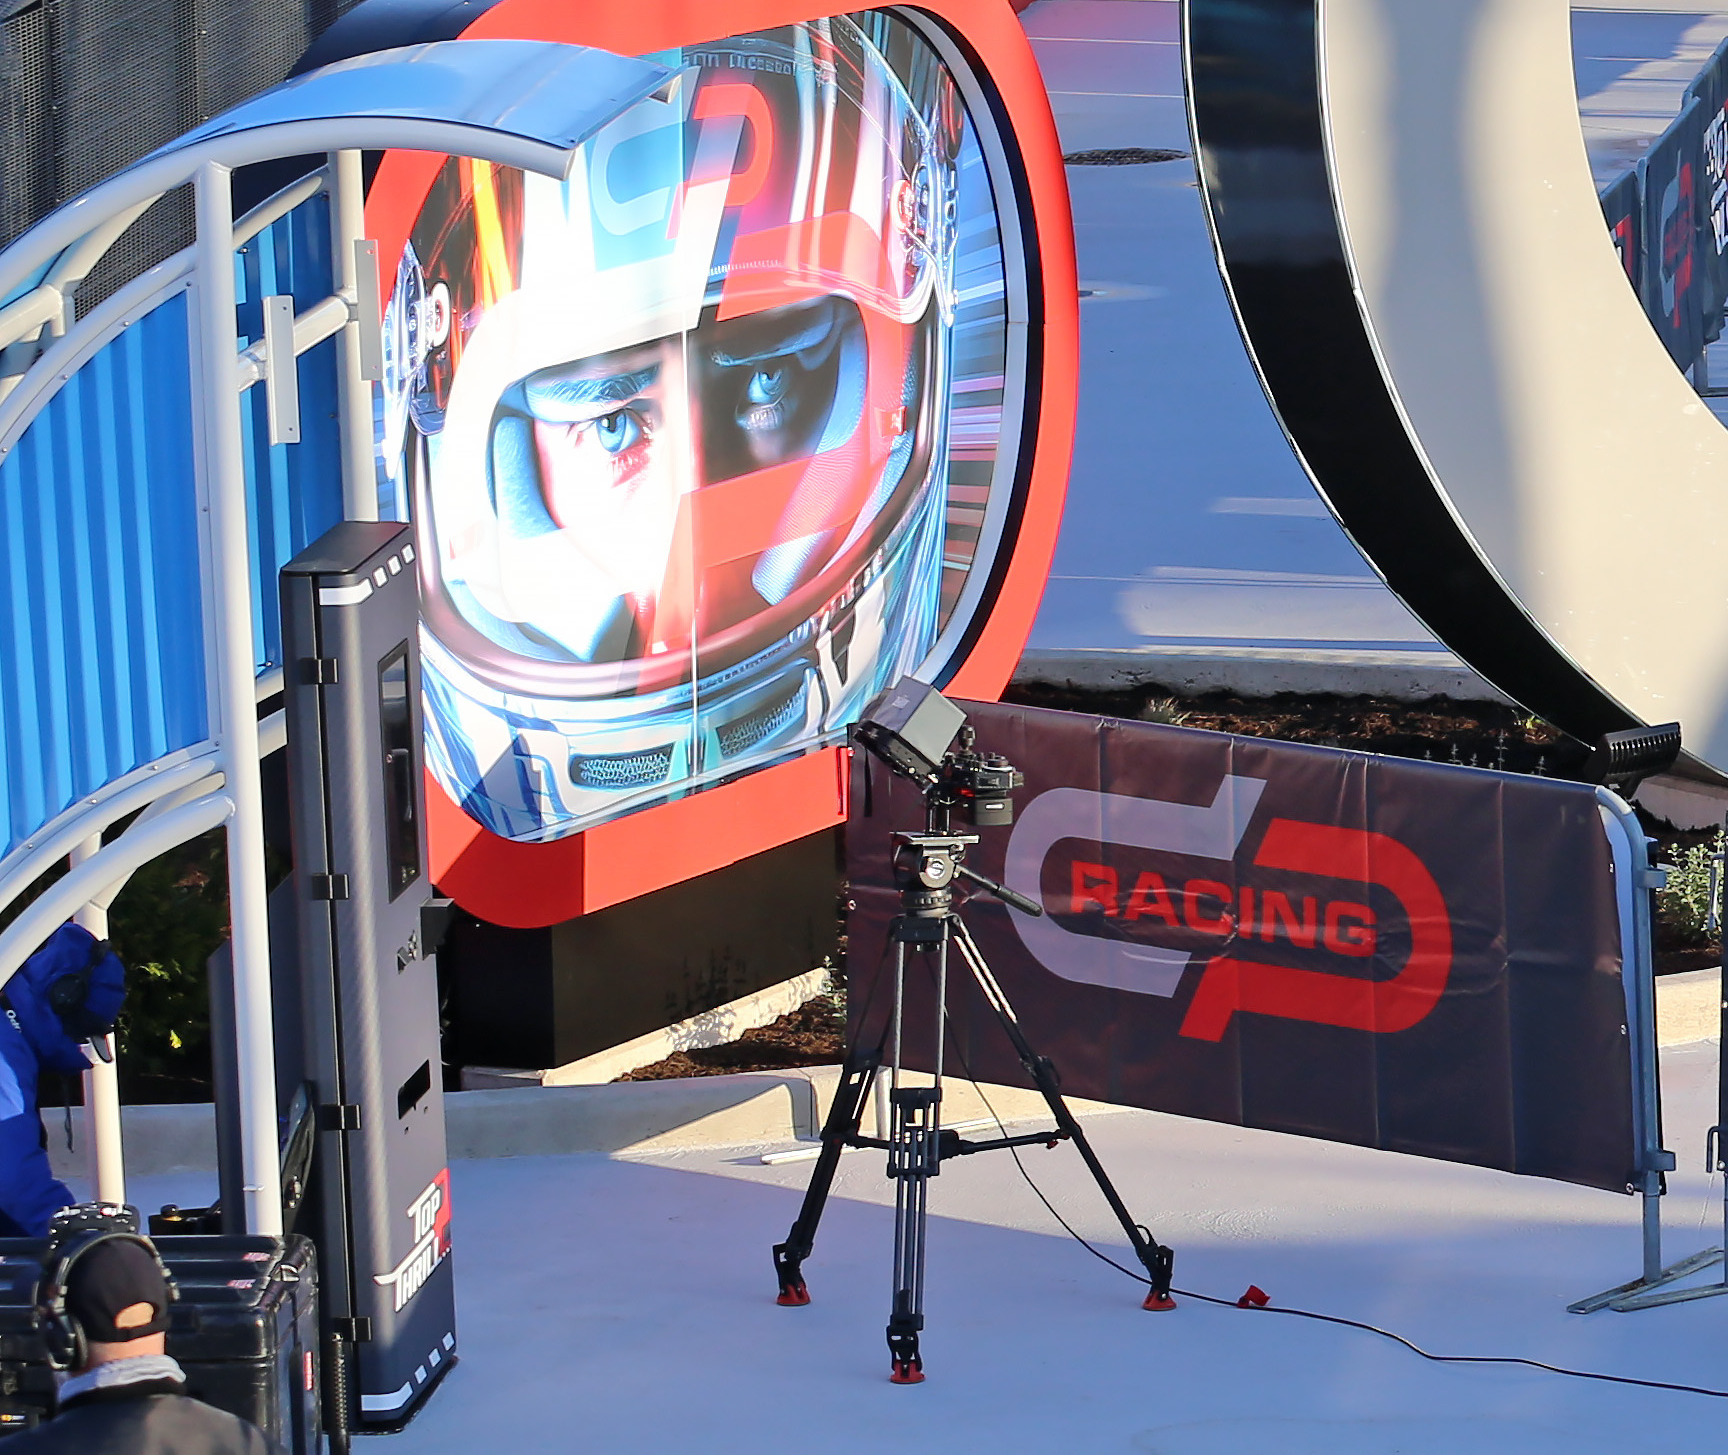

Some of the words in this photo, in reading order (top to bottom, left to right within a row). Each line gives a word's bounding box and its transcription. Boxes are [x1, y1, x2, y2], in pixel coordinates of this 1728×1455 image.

[1068, 859, 1380, 959] RACING
[407, 1182, 441, 1244] TOP
[373, 1229, 443, 1313] THRILL
